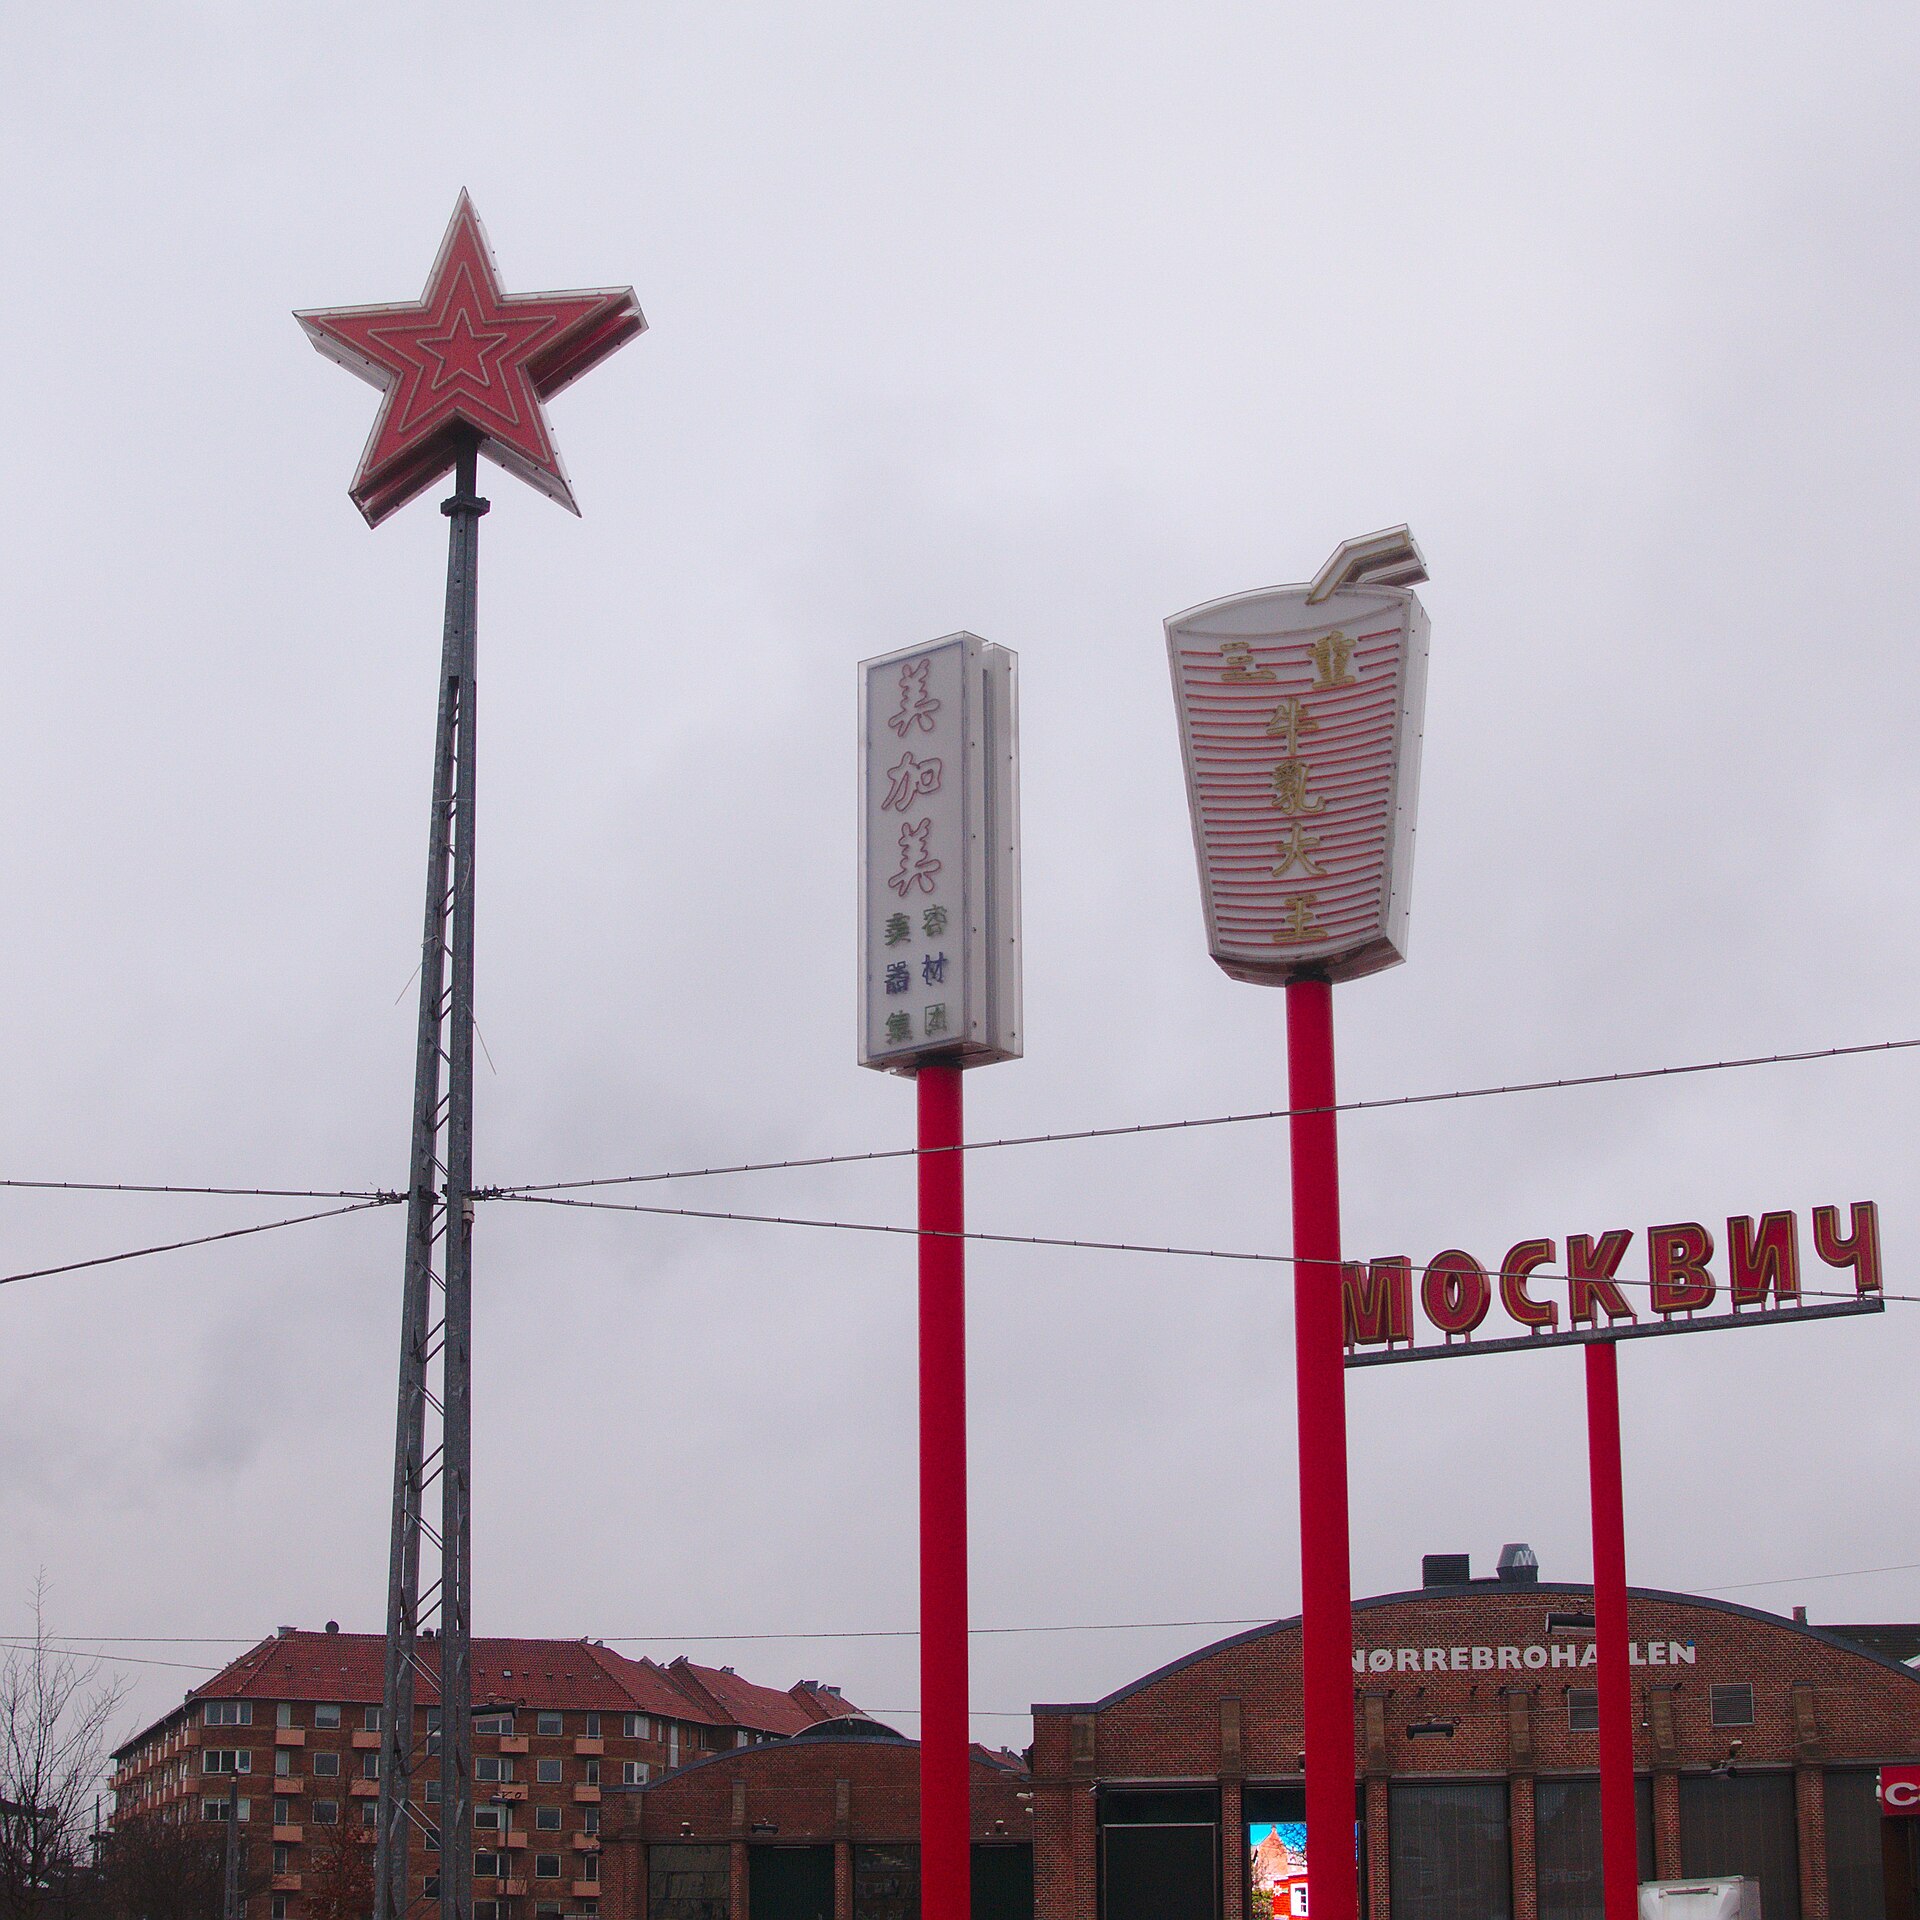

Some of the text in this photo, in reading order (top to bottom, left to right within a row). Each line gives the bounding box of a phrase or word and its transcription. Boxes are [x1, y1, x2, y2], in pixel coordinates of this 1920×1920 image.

[881, 658, 943, 897] 美加美
[1266, 697, 1328, 942] 牛乳大王
